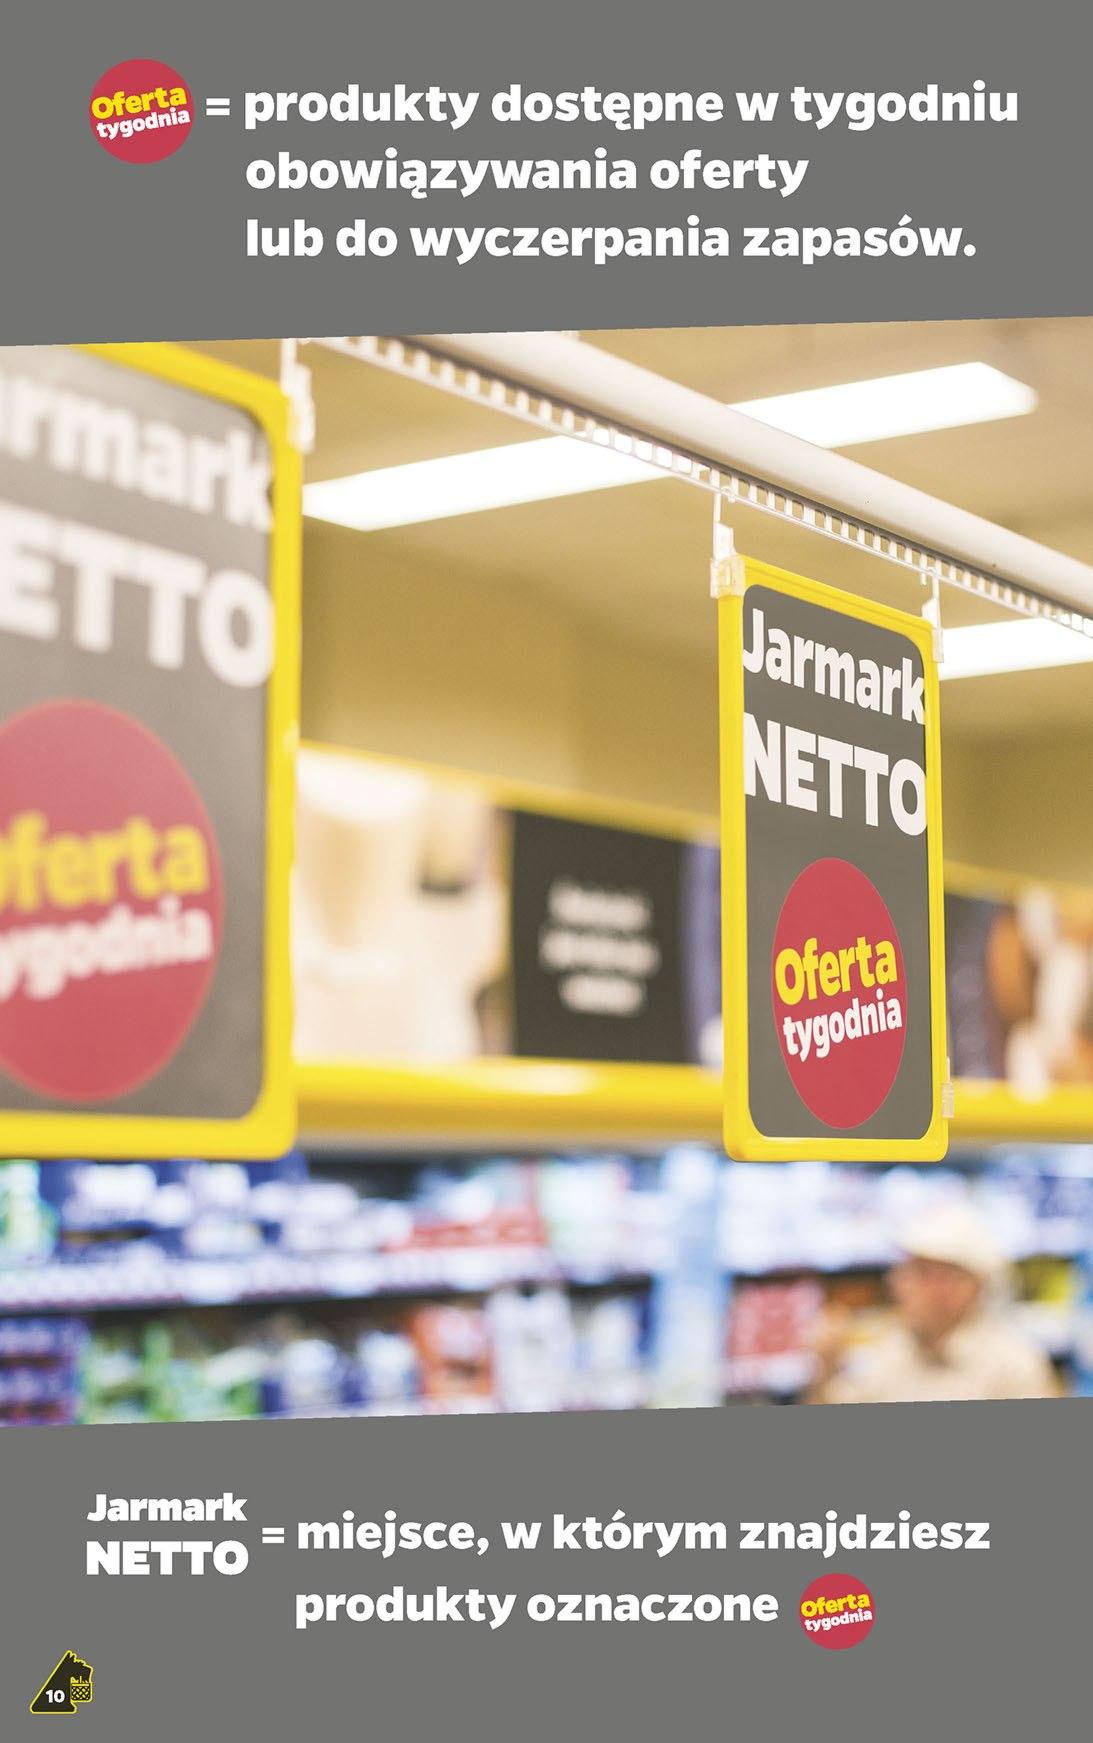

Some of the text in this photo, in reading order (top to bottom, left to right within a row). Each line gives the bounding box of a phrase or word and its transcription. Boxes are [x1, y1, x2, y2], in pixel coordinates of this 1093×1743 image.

[0, 376, 273, 532] rmark
[743, 608, 925, 725] Jarmark
[743, 711, 927, 836] NETTO
[775, 936, 898, 1006] Oferta
[783, 988, 902, 1062] tygodnia
